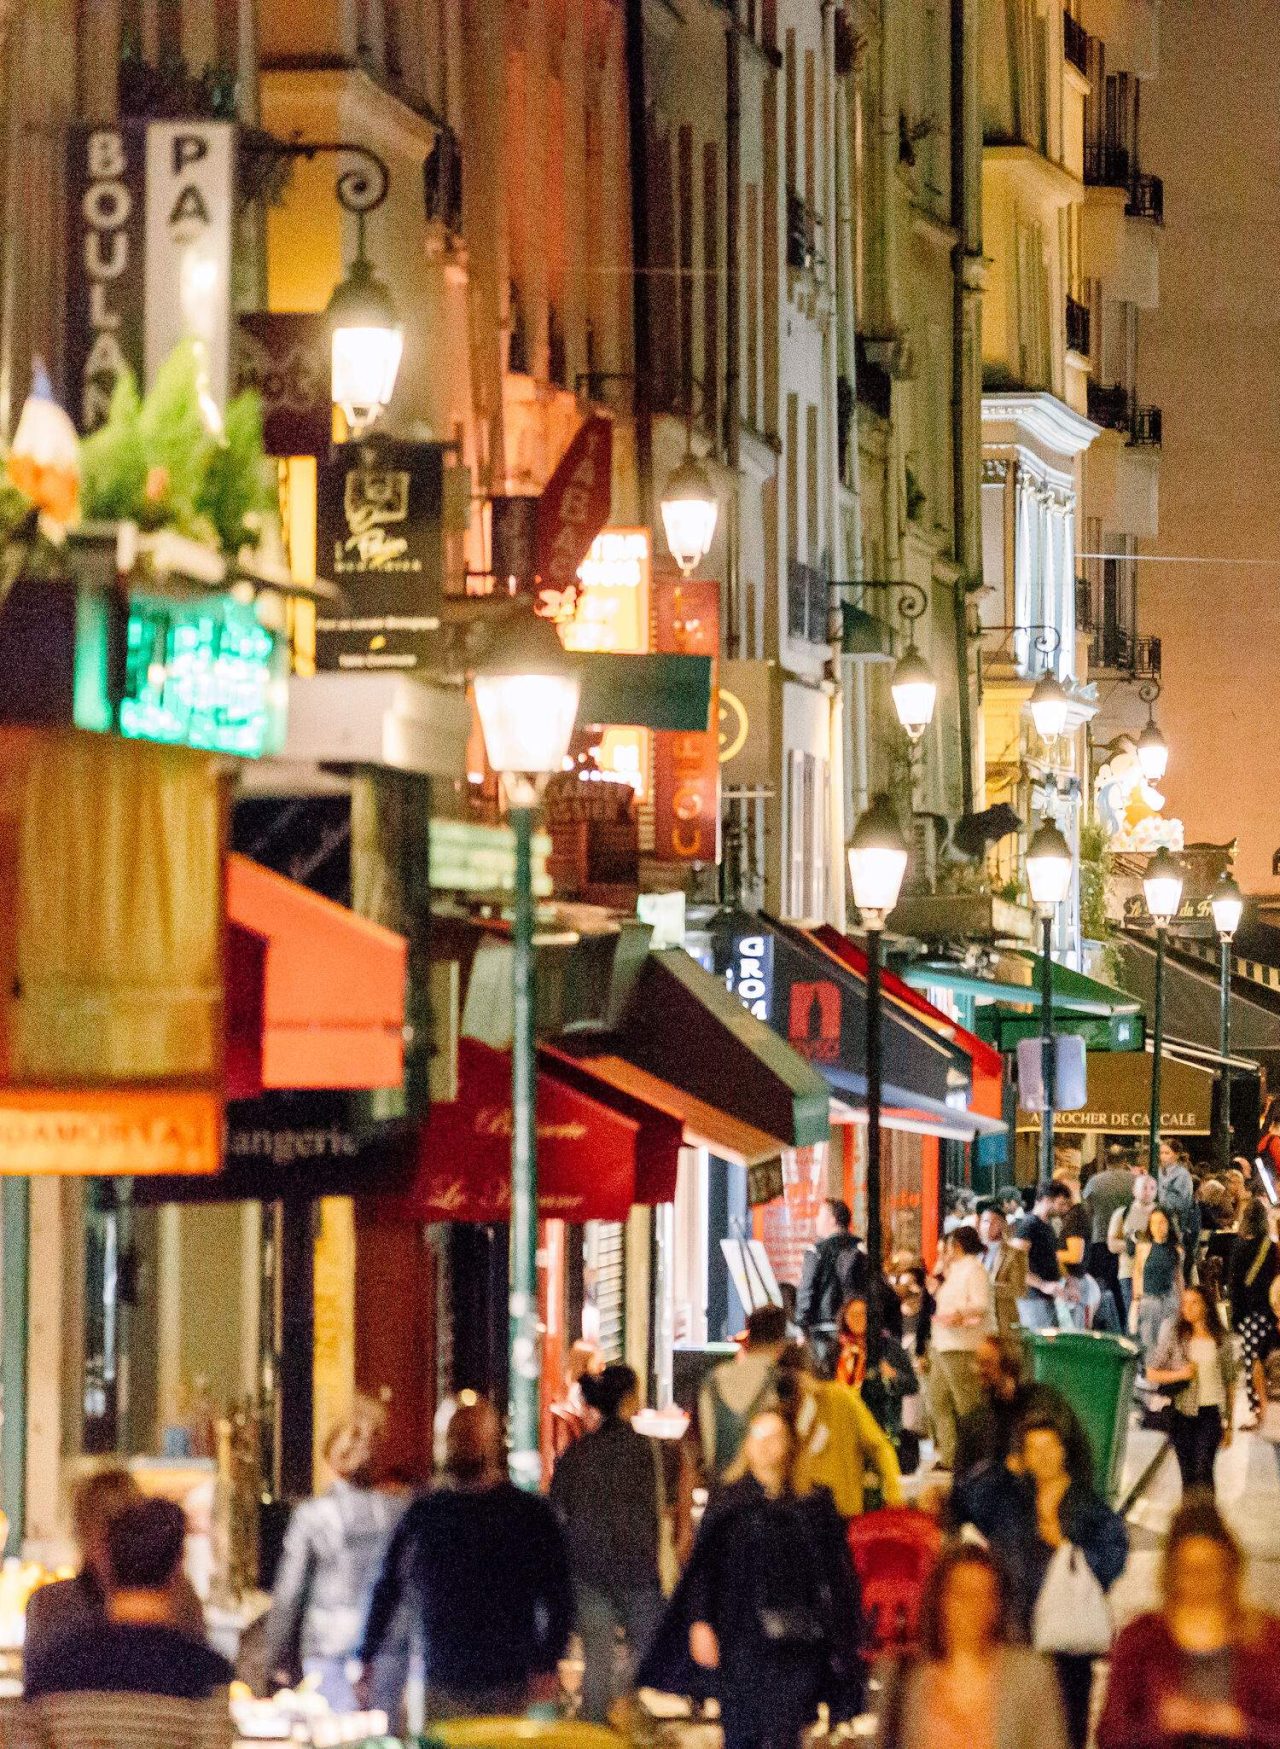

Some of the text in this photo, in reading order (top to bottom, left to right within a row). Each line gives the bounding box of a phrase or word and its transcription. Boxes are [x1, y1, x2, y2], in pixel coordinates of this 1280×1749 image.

[1053, 1112, 1107, 1125] ROCHER
[1110, 1113, 1129, 1125] DE
[1131, 1113, 1196, 1126] CACALE
